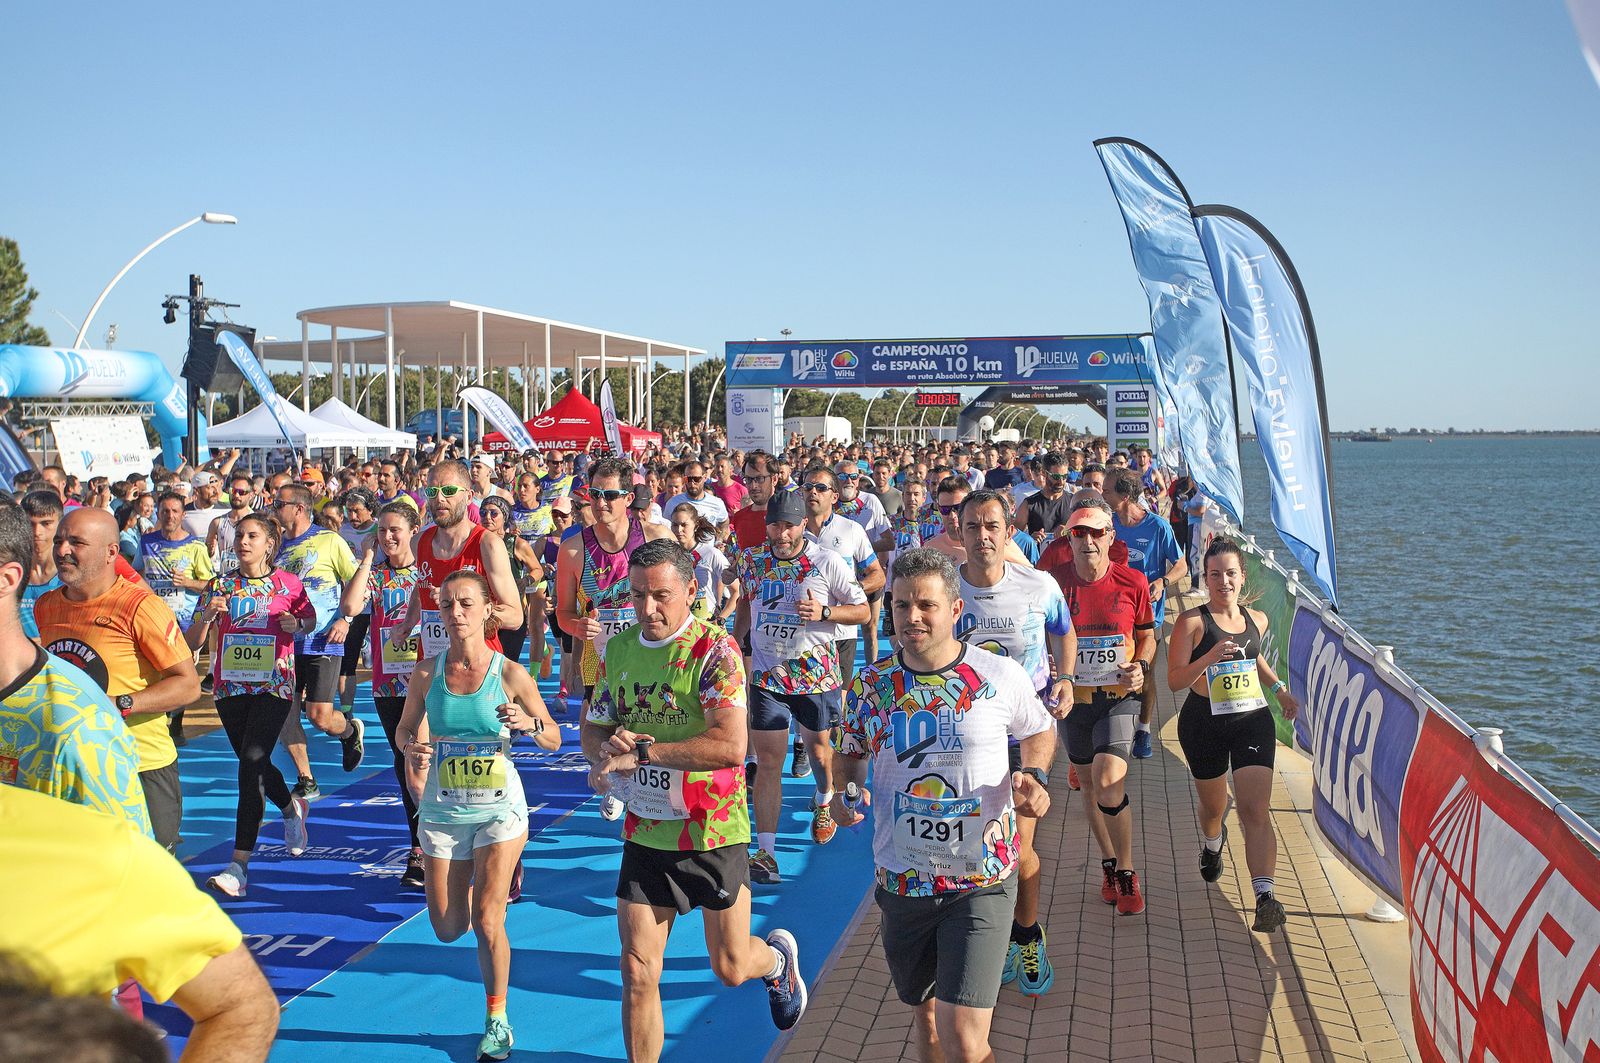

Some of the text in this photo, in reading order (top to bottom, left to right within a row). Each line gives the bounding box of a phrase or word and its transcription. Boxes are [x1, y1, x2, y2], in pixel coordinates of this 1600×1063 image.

[872, 344, 968, 357] CAMPEONATO
[88, 359, 127, 378] HUELVA
[791, 349, 815, 380] 10
[871, 356, 1002, 372] de ESPAÑA 10 km
[1015, 346, 1079, 377] 10 HUELVA
[976, 372, 1003, 380] Master
[489, 440, 577, 450] SPORANIACS
[762, 580, 785, 611] 10
[230, 595, 257, 628] 10
[976, 617, 1015, 629] HUELVA
[426, 624, 448, 638] 161
[763, 624, 797, 639] 1757
[49, 640, 97, 662] PARTAN
[234, 647, 262, 661] 904
[1077, 649, 1117, 665] 1759
[1222, 674, 1250, 690] 875
[938, 723, 964, 737] EL
[891, 709, 964, 769] 10 HU
[939, 737, 963, 751] VA
[448, 759, 495, 776] 1167
[924, 760, 963, 768] DESCUBRIMIENTO
[949, 803, 973, 815] 2023
[906, 816, 964, 843] 1291
[258, 844, 379, 856] HUEVA
